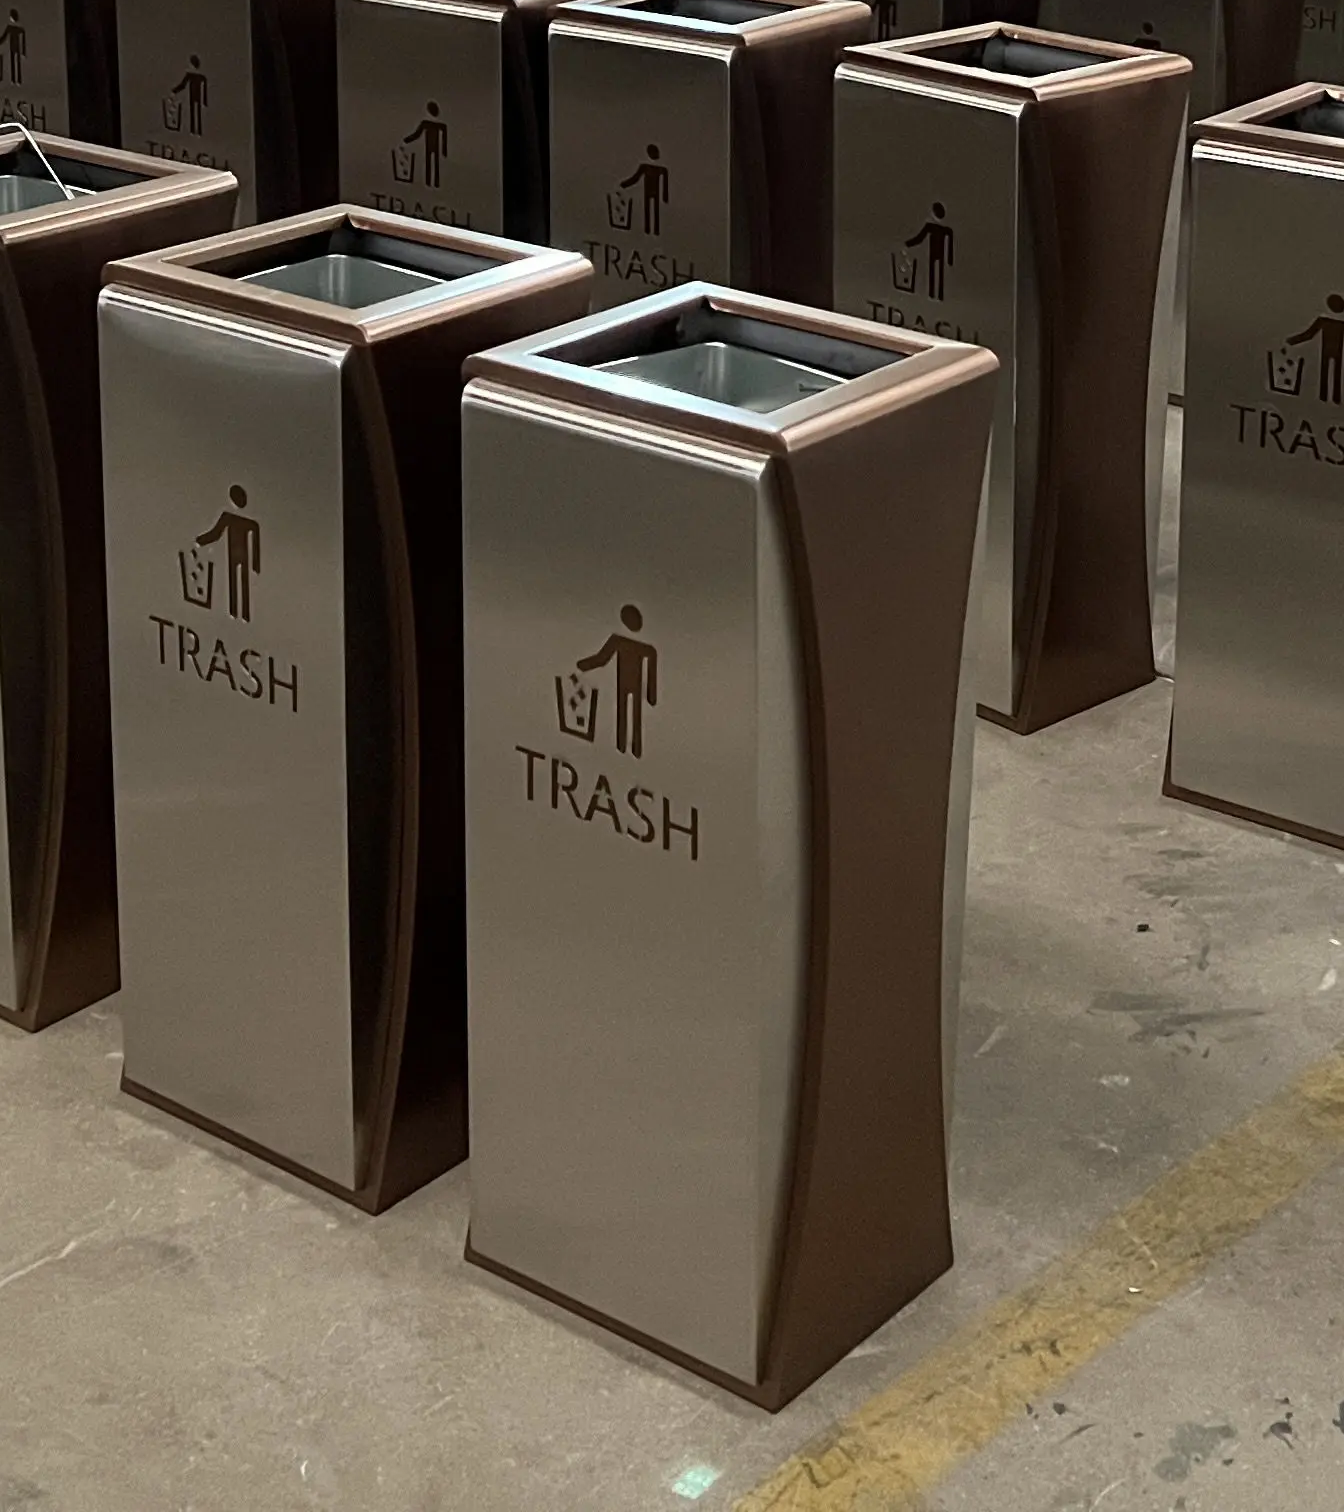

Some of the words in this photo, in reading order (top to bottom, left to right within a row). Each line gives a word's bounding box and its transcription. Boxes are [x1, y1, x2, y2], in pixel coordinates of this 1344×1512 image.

[582, 240, 697, 288] TRASH
[149, 614, 299, 713] TRASH
[515, 744, 700, 861] TRASH
